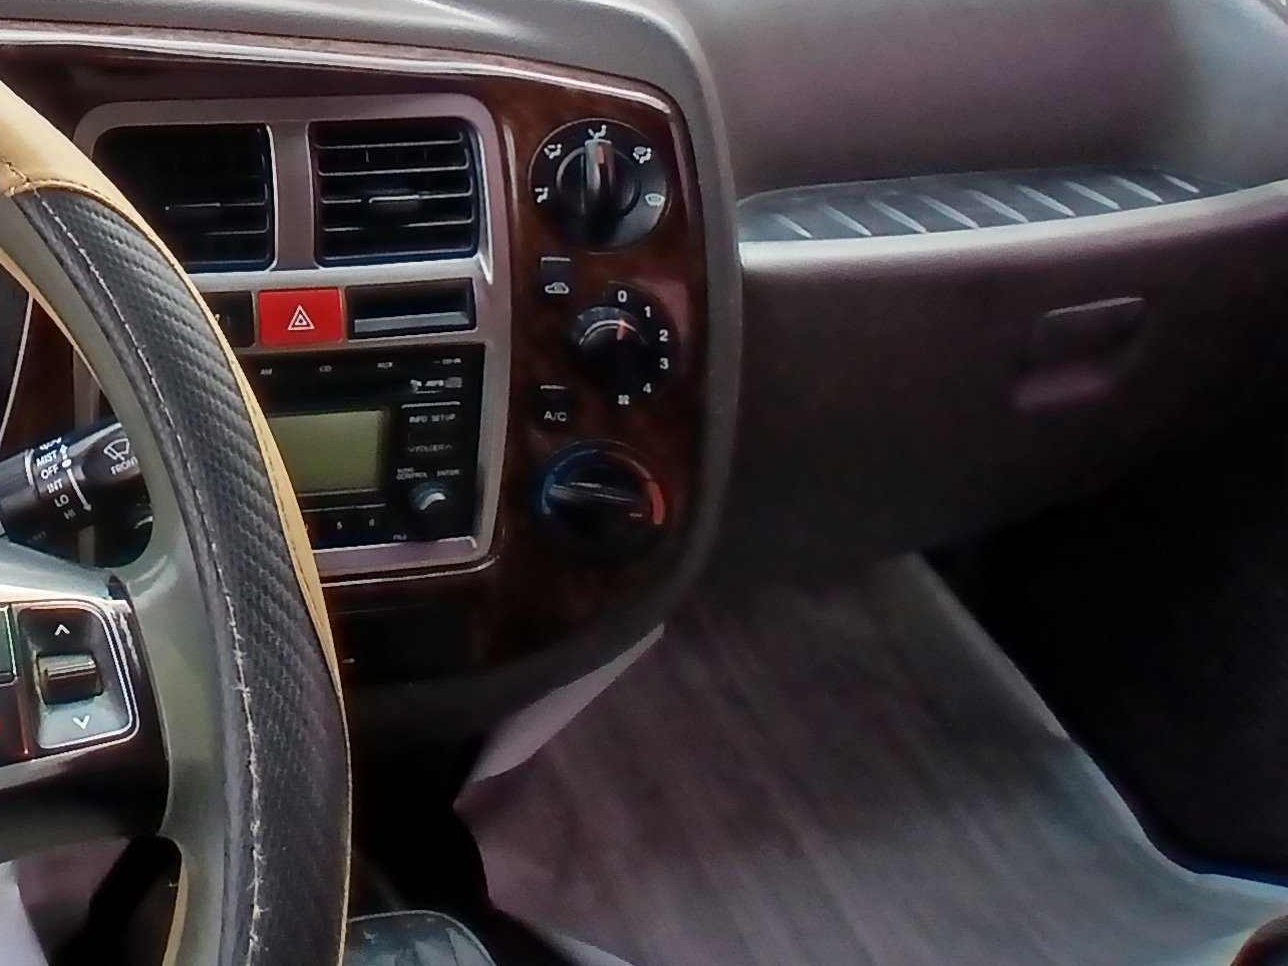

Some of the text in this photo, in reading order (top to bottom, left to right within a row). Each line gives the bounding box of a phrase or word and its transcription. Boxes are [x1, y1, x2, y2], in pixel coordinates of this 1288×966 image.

[617, 290, 628, 303] 0
[644, 306, 652, 318] 1
[659, 329, 669, 342] 2
[659, 358, 669, 369] 3
[642, 383, 652, 394] 4
[543, 410, 567, 423] A/C
[36, 449, 58, 468] MIST
[41, 465, 60, 479] OFF
[47, 478, 63, 494] INT
[54, 494, 70, 508] LO
[63, 508, 77, 520] HI
